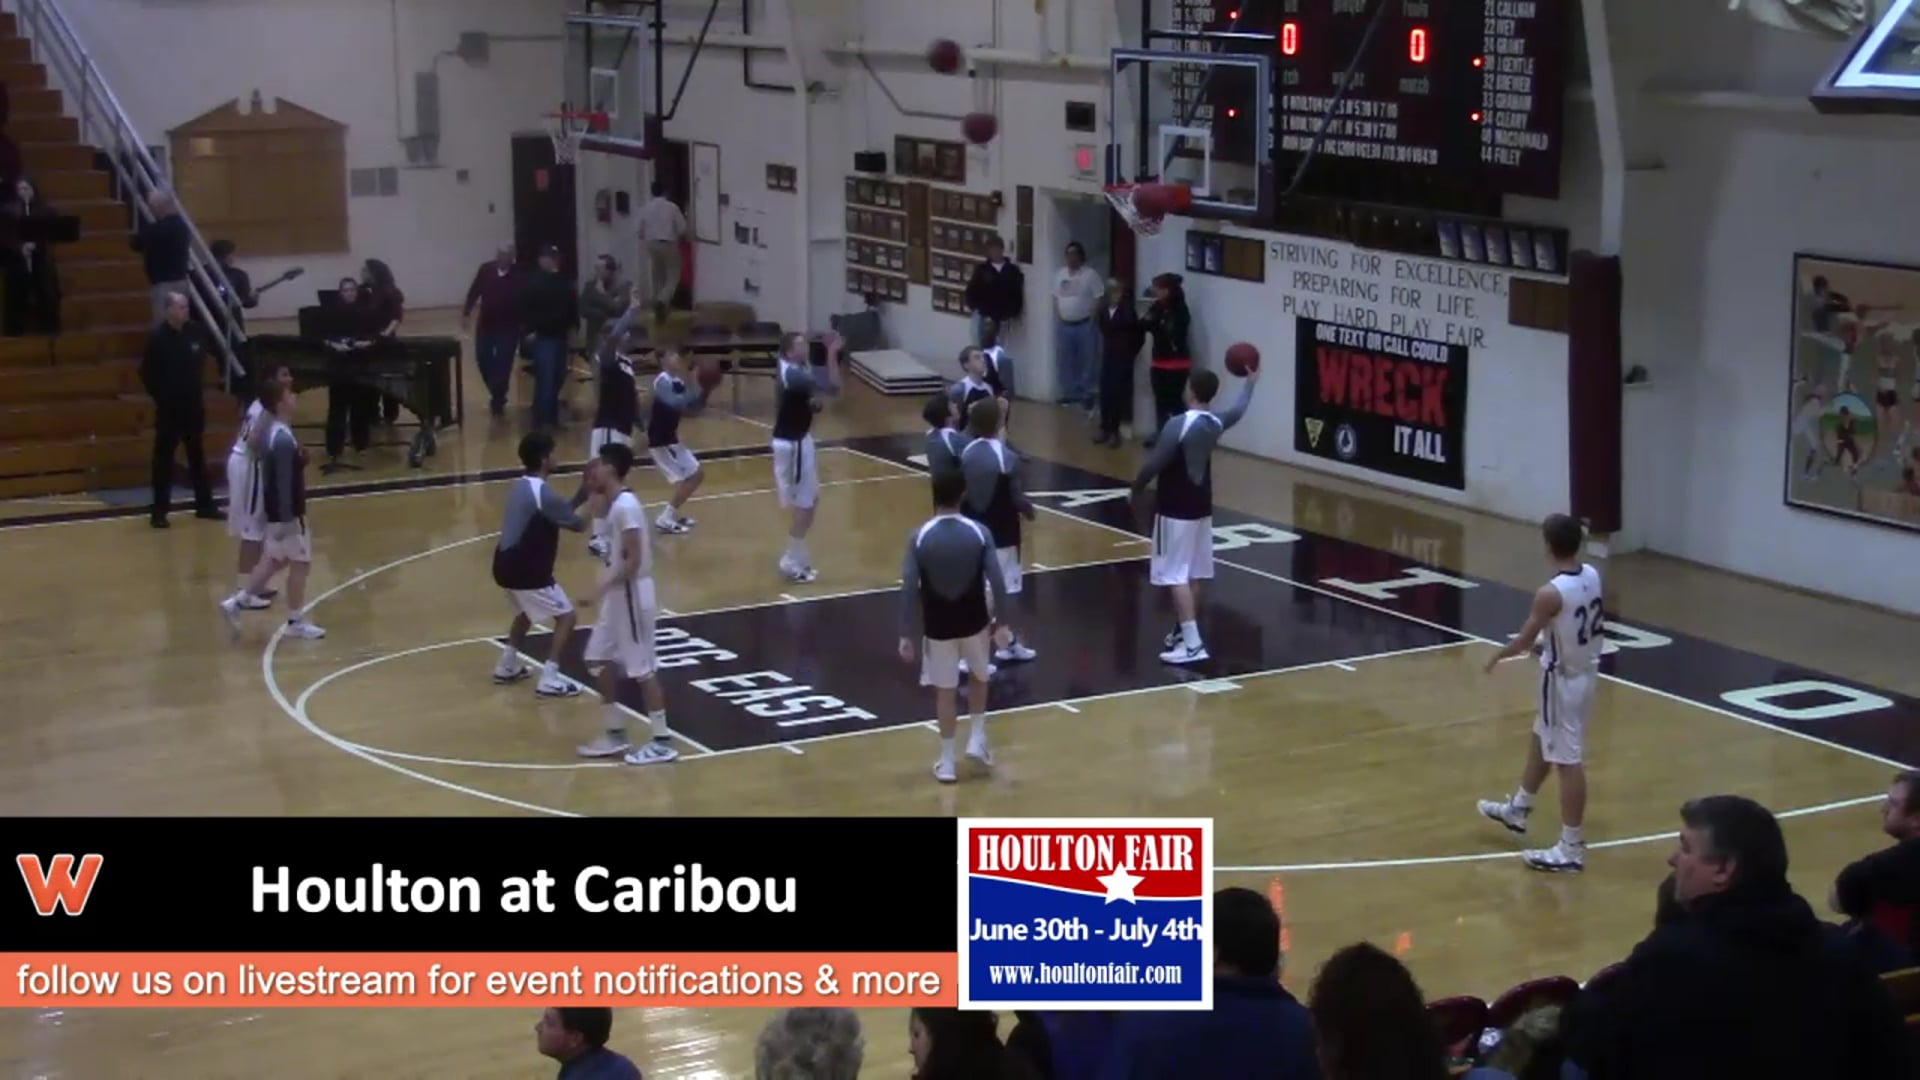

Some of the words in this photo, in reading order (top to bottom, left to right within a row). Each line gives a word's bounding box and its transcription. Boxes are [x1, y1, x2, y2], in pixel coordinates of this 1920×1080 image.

[1283, 23, 1296, 55] 0
[1410, 29, 1425, 62] 0
[1269, 241, 1339, 269] STRIVING
[1349, 252, 1381, 276] FOR
[1292, 270, 1379, 303] PREPARING
[1391, 285, 1421, 309] FOR
[1282, 295, 1320, 318] PLAY
[1391, 313, 1431, 338] PLAY
[1316, 322, 1337, 342] ONE
[1338, 326, 1365, 348] TEXT
[1366, 332, 1381, 351] OR
[1383, 335, 1409, 357] CALL
[1411, 340, 1449, 363] COULD
[1316, 346, 1448, 427] WRECK
[1394, 425, 1412, 453] IT
[1413, 430, 1446, 463] ALL
[689, 669, 878, 727] EAST
